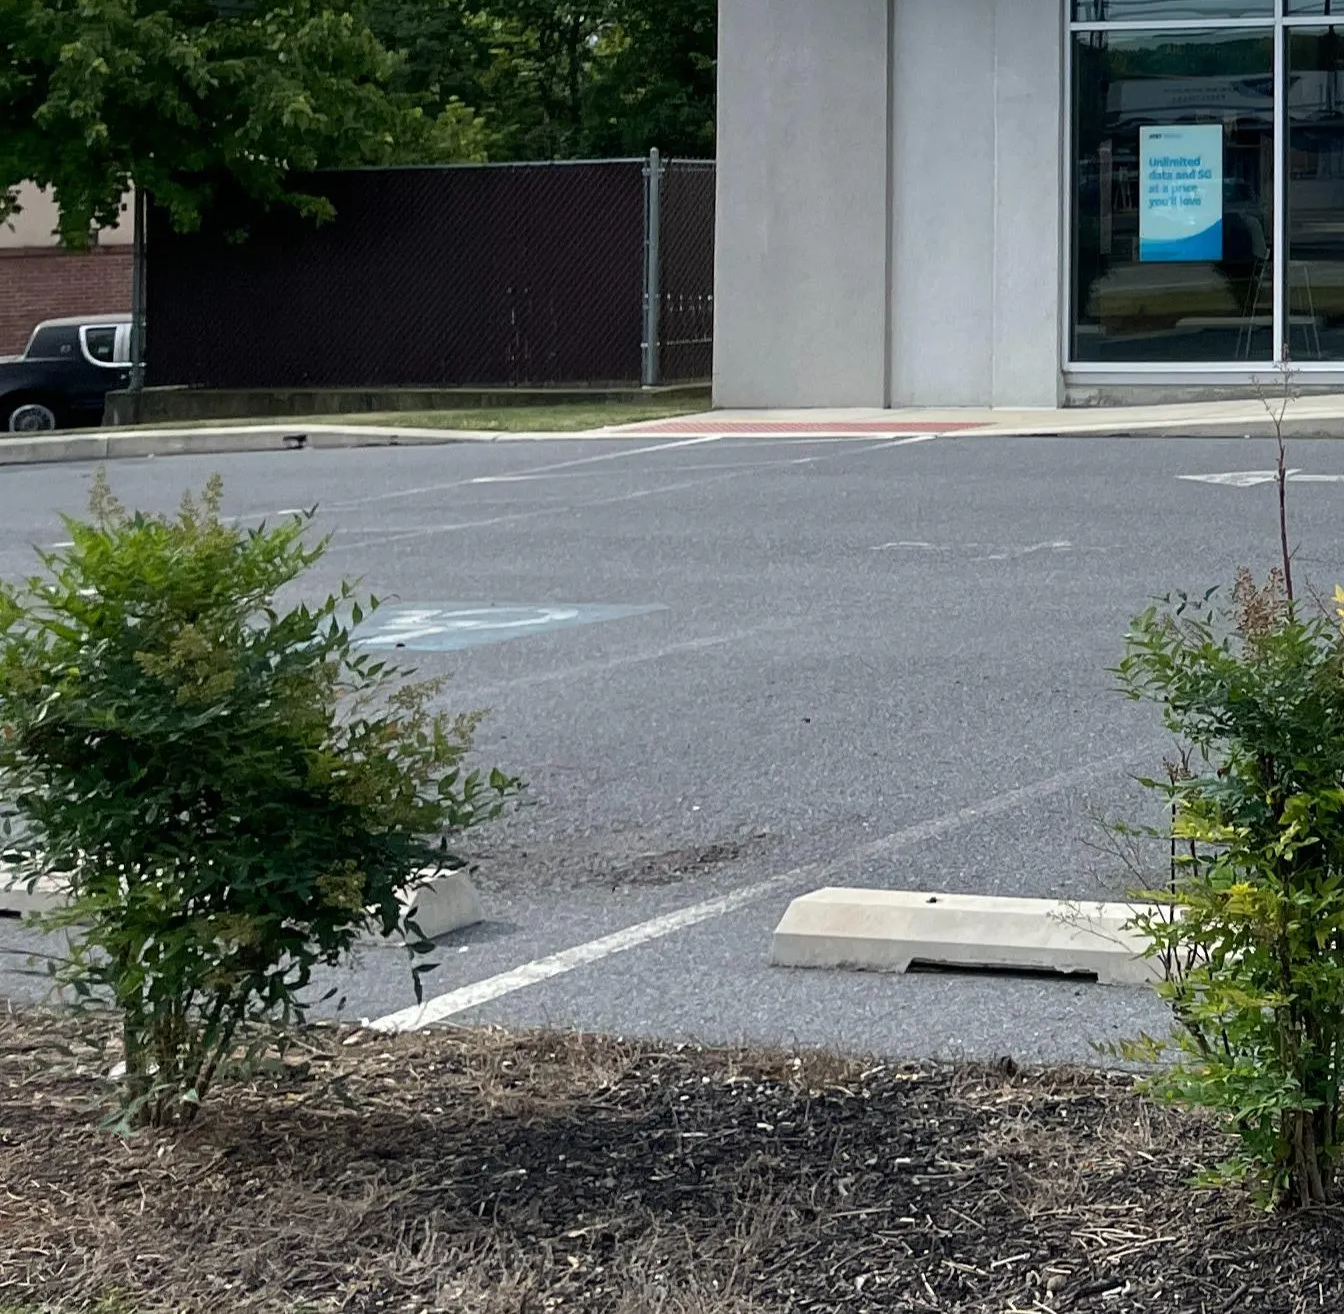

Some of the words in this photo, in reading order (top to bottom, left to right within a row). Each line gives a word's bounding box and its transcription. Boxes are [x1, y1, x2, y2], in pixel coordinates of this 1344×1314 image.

[1149, 156, 1200, 167] Unlimited
[1149, 170, 1172, 180] data
[1175, 170, 1195, 180] and
[1148, 184, 1159, 193] at
[1171, 184, 1198, 196] price
